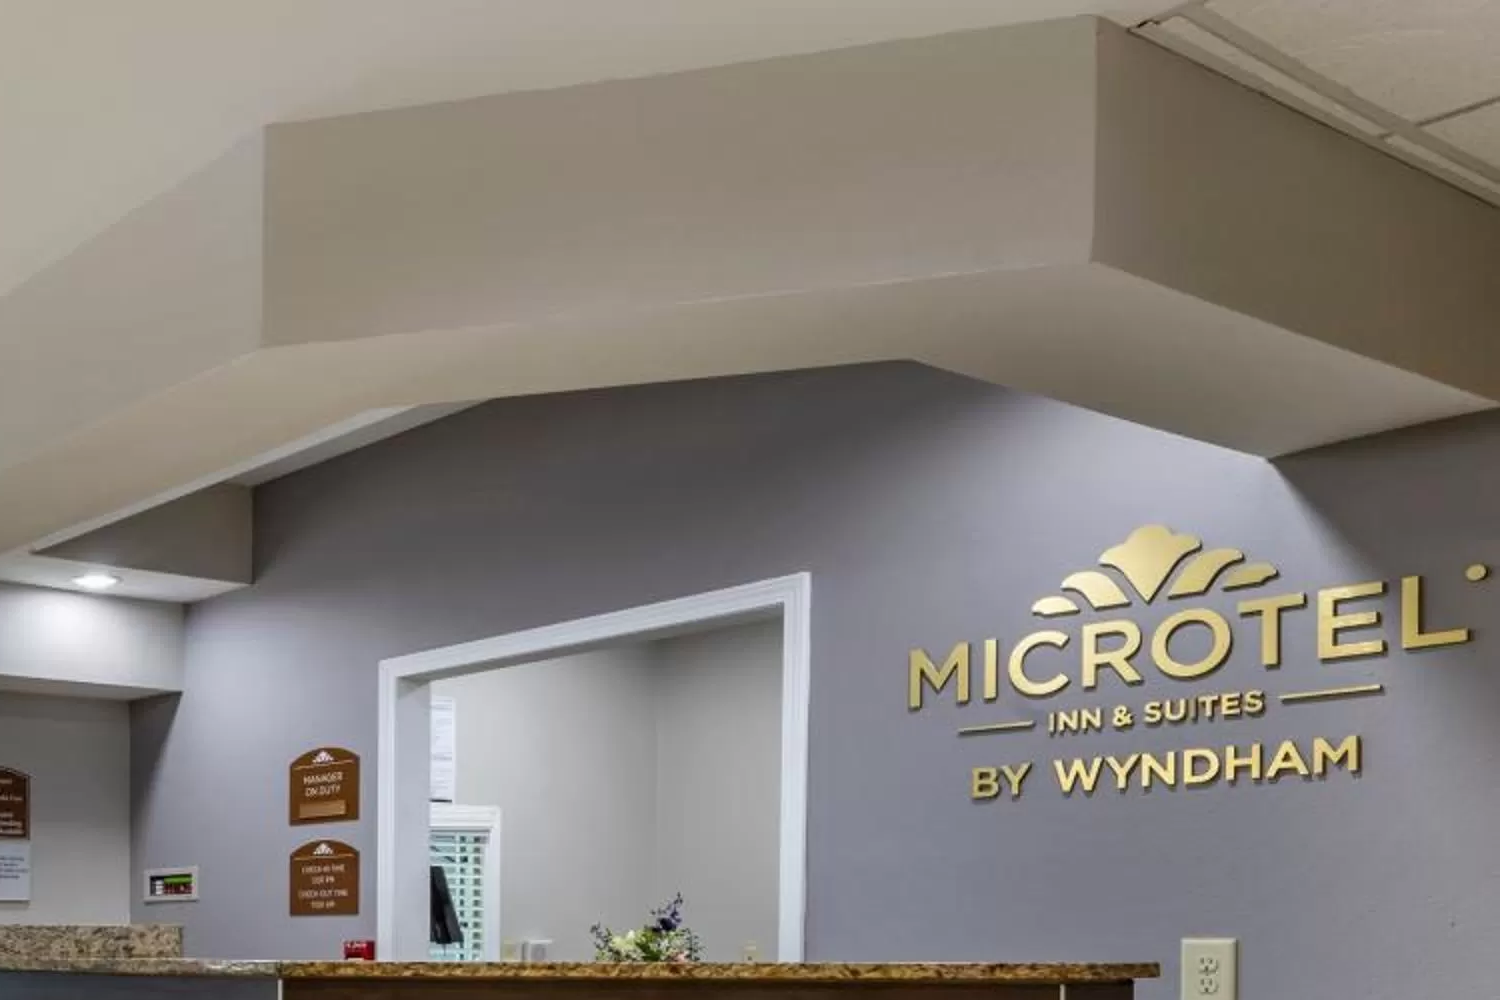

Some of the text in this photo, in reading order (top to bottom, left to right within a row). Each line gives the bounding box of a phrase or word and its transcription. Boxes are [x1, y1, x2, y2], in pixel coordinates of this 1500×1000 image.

[907, 574, 1471, 711] MICROTEL
[1047, 689, 1266, 736] INN & SUITES
[303, 771, 343, 785] MANAGER
[319, 784, 340, 795] DUTY
[971, 734, 1361, 801] BY WYNDHAM
